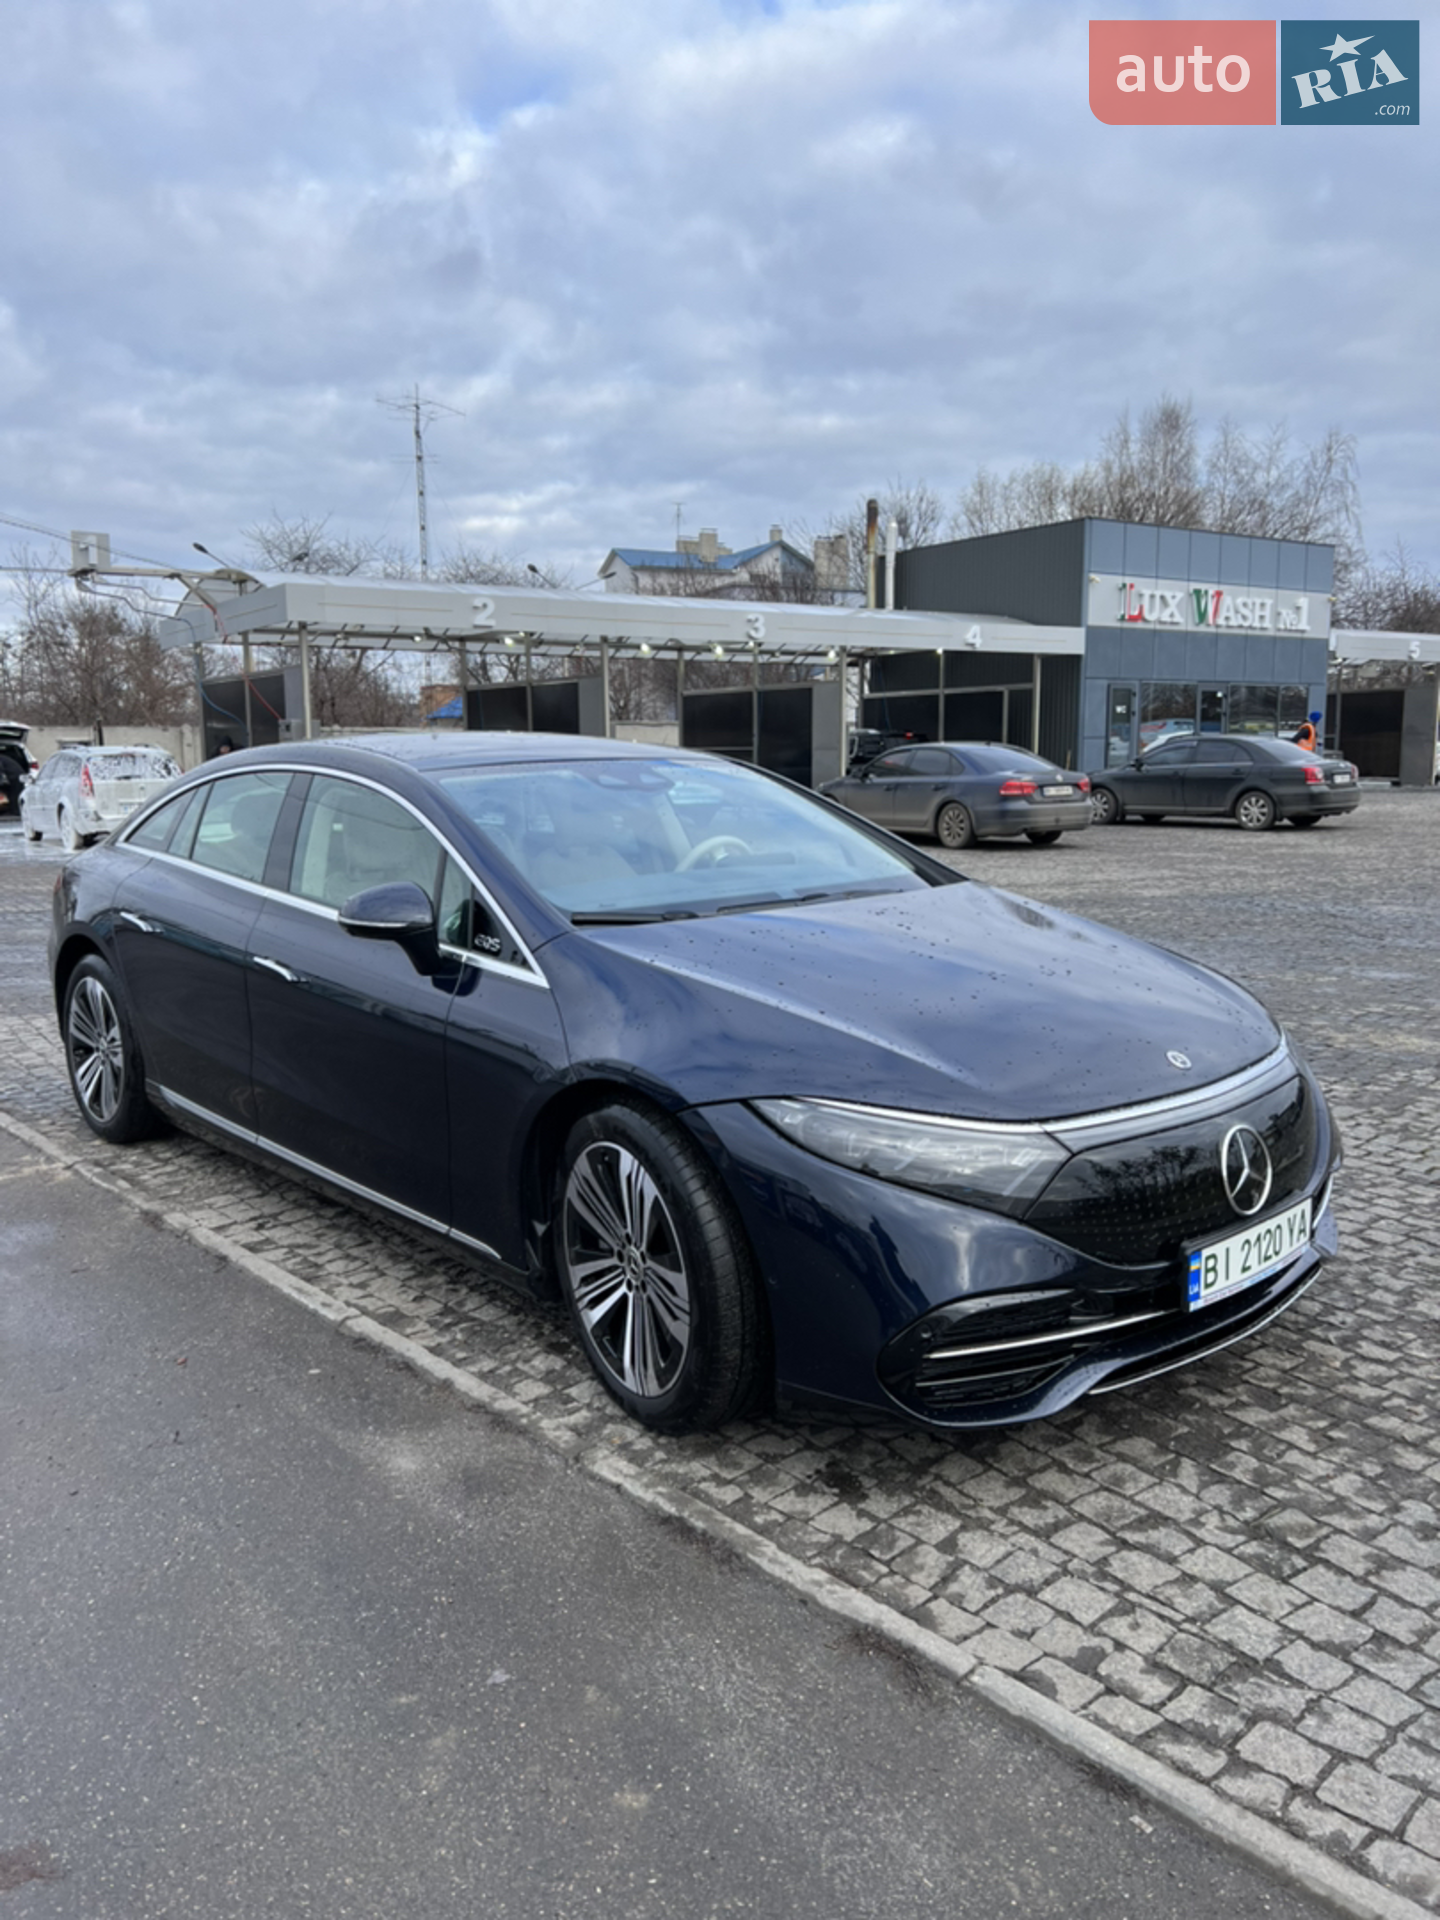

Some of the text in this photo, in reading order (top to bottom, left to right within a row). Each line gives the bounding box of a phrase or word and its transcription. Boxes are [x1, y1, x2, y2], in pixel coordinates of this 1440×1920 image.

[473, 597, 496, 628] 2
[1190, 587, 1274, 630] WASH
[747, 613, 766, 640] 3
[964, 625, 982, 649] 4
[1408, 641, 1421, 660] 5
[1240, 1223, 1283, 1274] 2120
